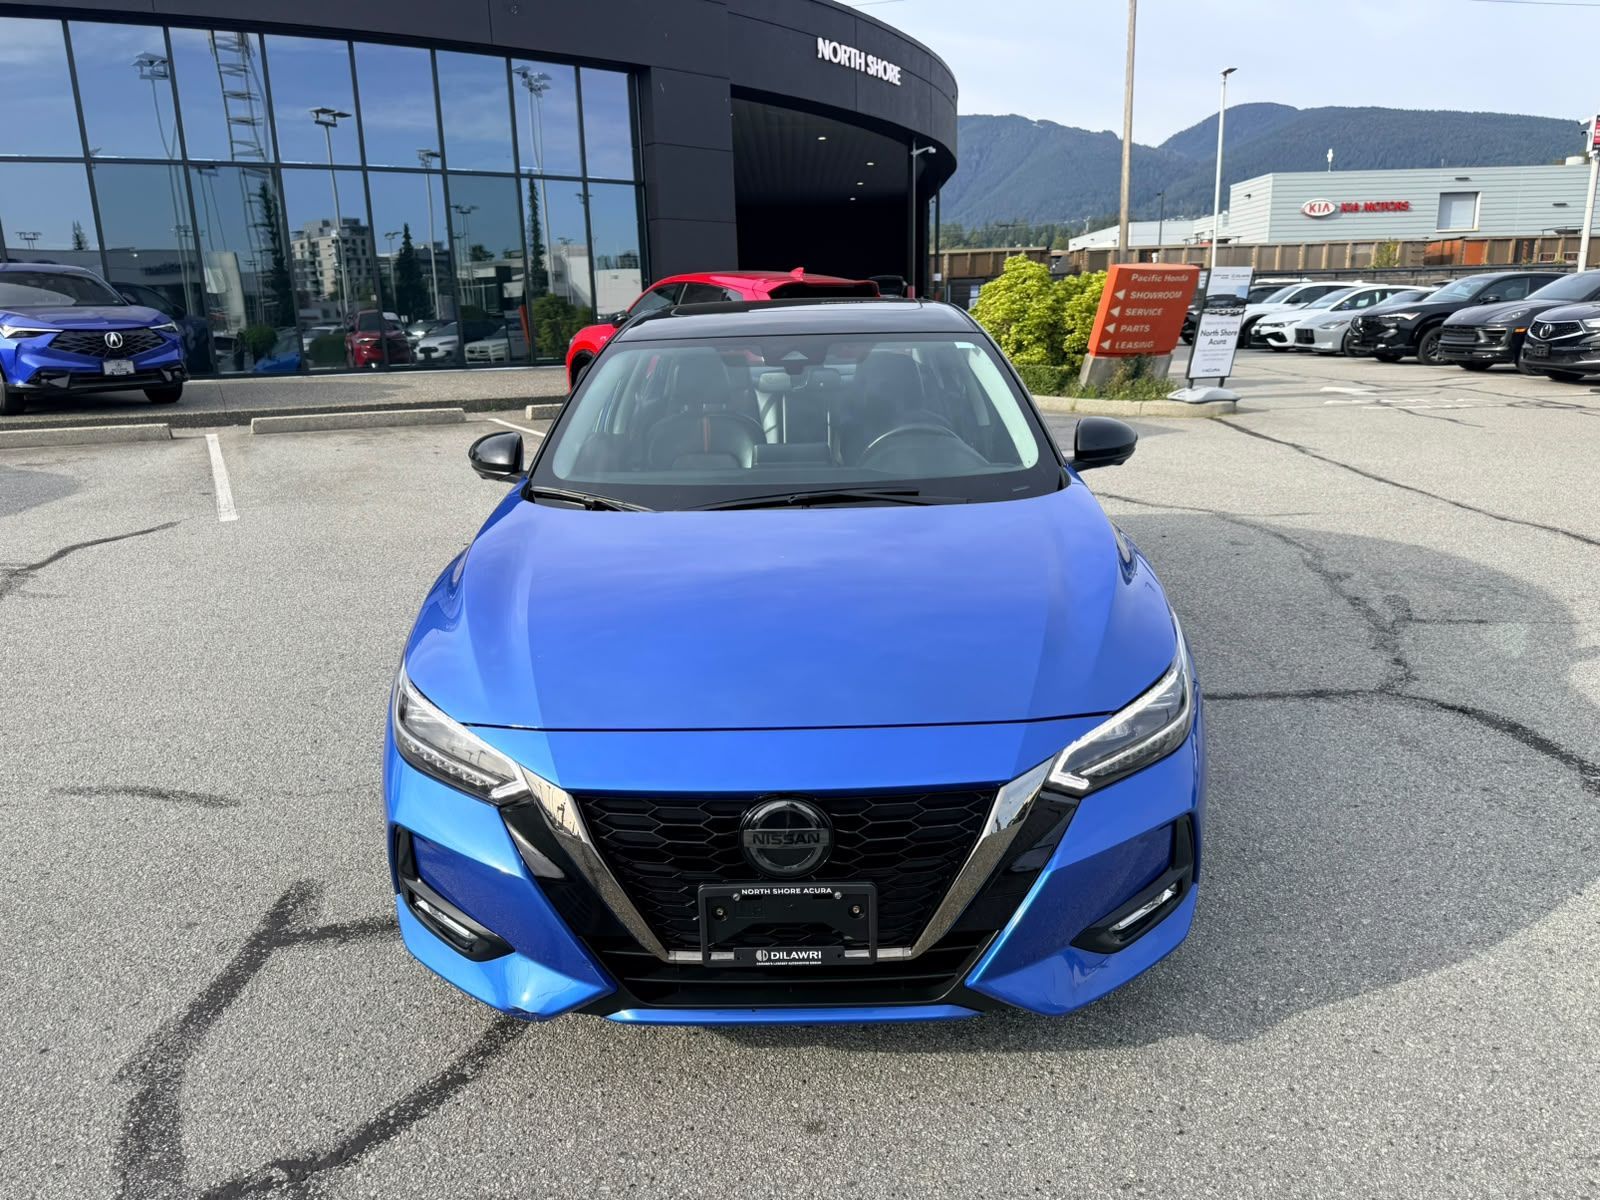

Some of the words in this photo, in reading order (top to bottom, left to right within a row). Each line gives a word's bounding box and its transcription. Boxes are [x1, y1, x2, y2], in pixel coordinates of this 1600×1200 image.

[817, 37, 865, 72] NORTH
[866, 54, 901, 86] SHORE
[1340, 202, 1360, 213] KIA
[1363, 201, 1410, 212] MOTORS
[1131, 273, 1162, 282] Pacific
[1164, 274, 1189, 282] Honda
[1130, 291, 1182, 300] SHOWROOM
[1125, 308, 1163, 316] SERVICE
[1200, 329, 1219, 337] North
[1220, 328, 1238, 337] Shore
[1115, 341, 1154, 349] LEASING
[752, 832, 820, 845] NISSAN
[770, 951, 822, 960] DILAWRI
